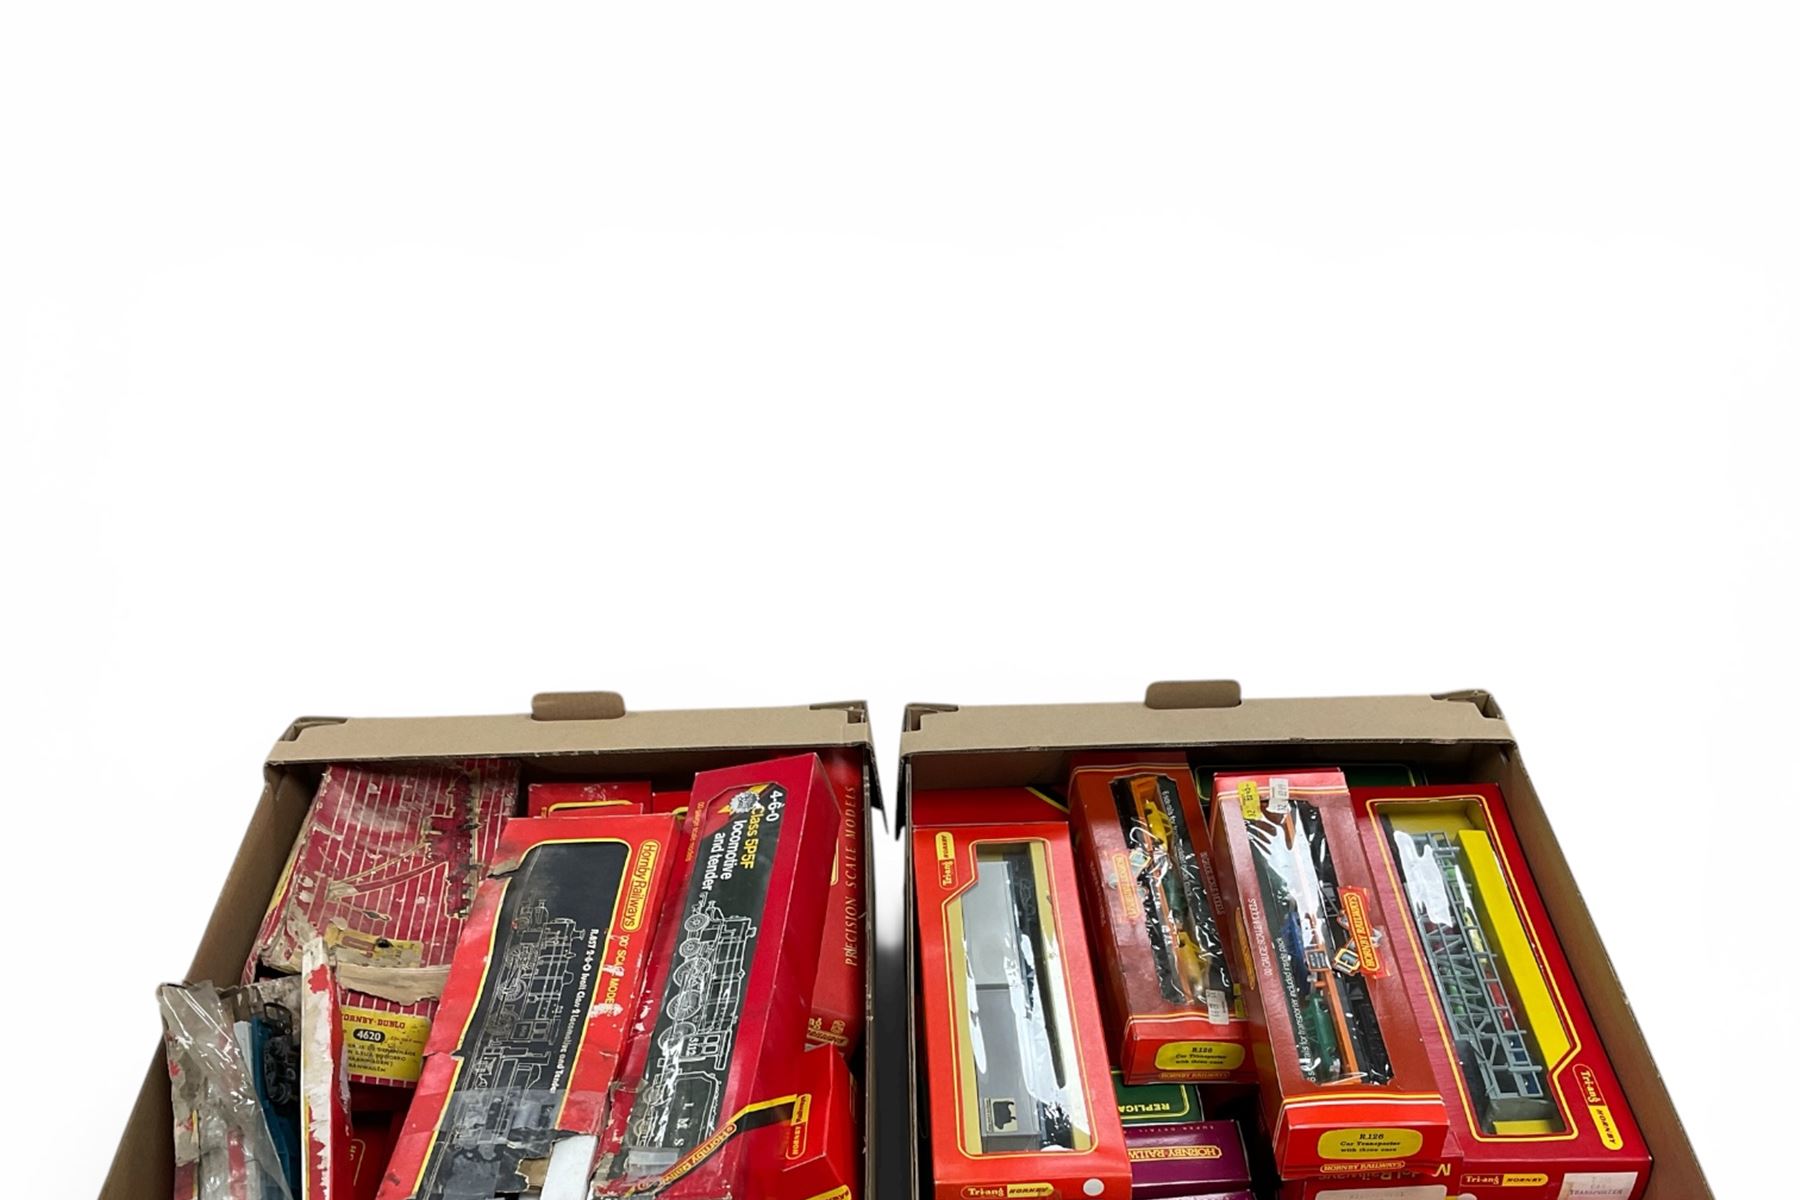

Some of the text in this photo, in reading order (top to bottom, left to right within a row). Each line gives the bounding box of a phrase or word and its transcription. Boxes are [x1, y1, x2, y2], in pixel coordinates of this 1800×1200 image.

[766, 790, 785, 821] 4-6-0
[720, 820, 747, 880] locomotive
[740, 805, 765, 869] Class 5P5F
[702, 832, 726, 890] and tender
[844, 786, 858, 967] PRECISION SCALE MODELS
[625, 844, 657, 927] Hornby Railways
[1276, 936, 1286, 953] pack
[1283, 970, 1297, 998] included
[1289, 996, 1306, 1035] transporter
[356, 1029, 381, 1042] 4620
[559, 1013, 578, 1054] Locomotive
[1297, 1033, 1308, 1045] for
[555, 1052, 567, 1069] and
[1118, 1103, 1170, 1113] REPLICA
[1596, 1108, 1616, 1144] HORNBY
[690, 1130, 728, 1163] Hornby
[1129, 1148, 1216, 1159] HORNBY RAILW
[1466, 1176, 1500, 1185] Tri-ang
